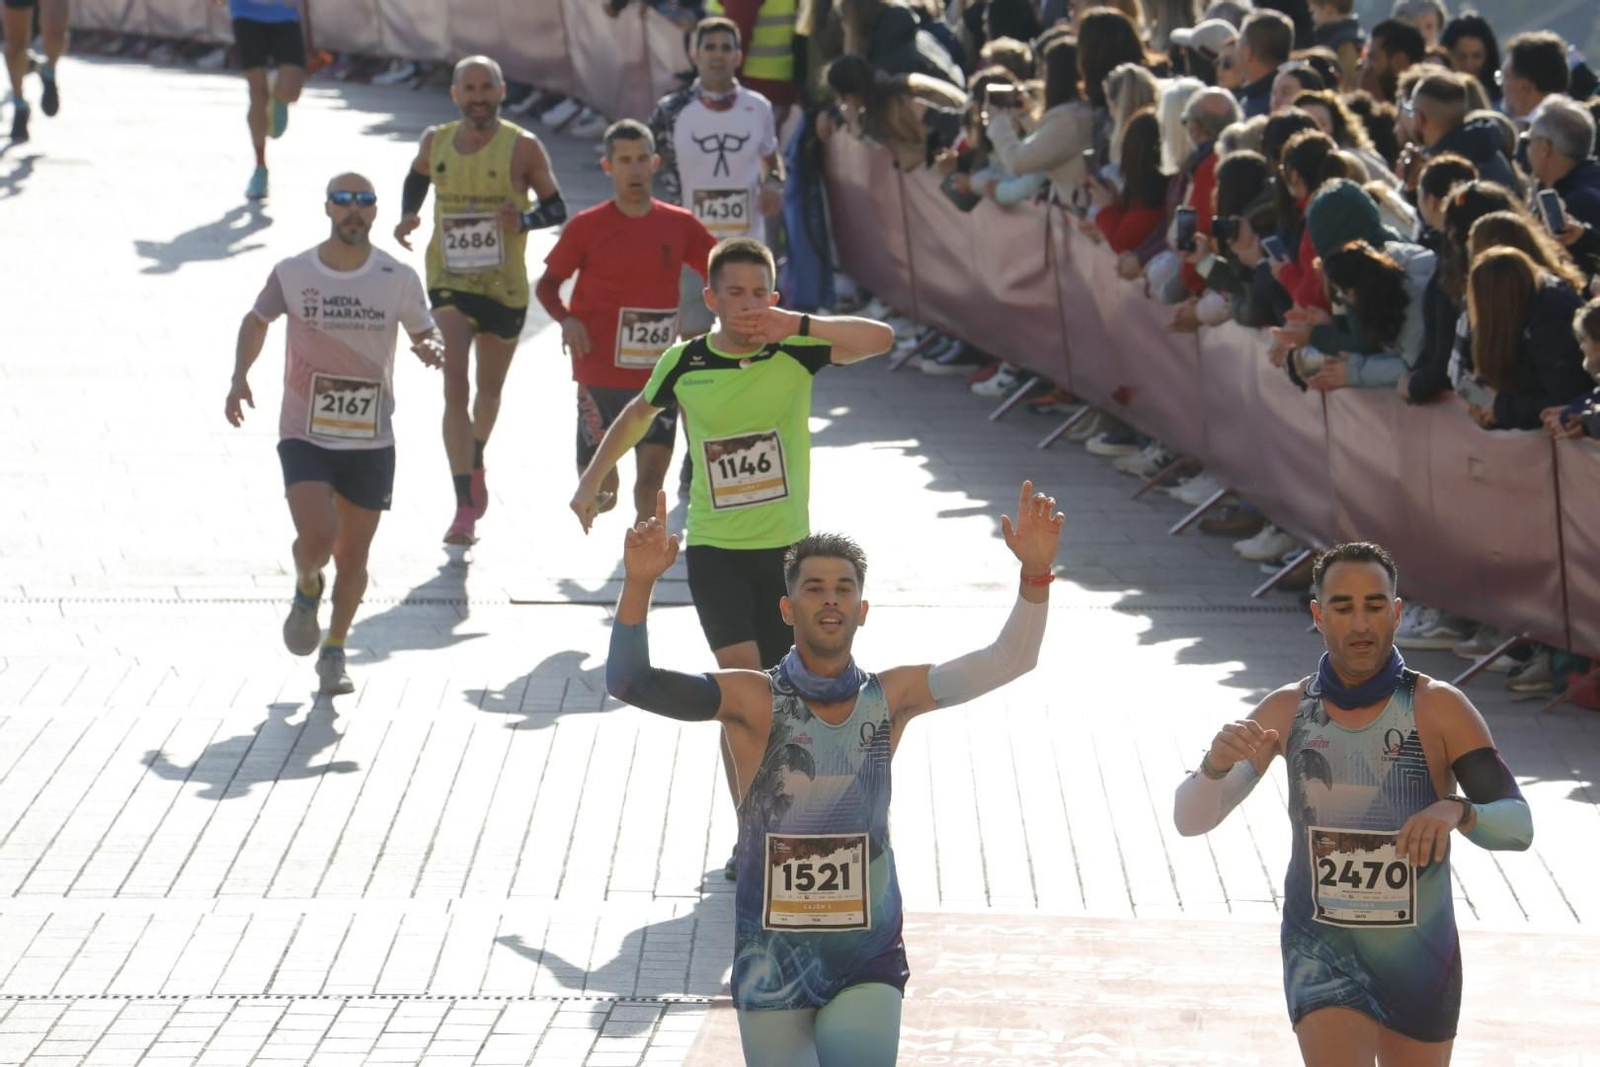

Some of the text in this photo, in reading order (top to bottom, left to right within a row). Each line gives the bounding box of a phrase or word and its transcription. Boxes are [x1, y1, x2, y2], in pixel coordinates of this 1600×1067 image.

[698, 203, 743, 218] 1430
[447, 231, 496, 249] 2686
[322, 296, 361, 307] MEDIA
[303, 306, 318, 317] 37
[323, 307, 385, 319] MARATÓN
[627, 326, 670, 344] 1268
[321, 394, 372, 415] 2167
[718, 452, 771, 479] 1146
[783, 862, 850, 891] 1521
[1319, 858, 1408, 889] 2470
